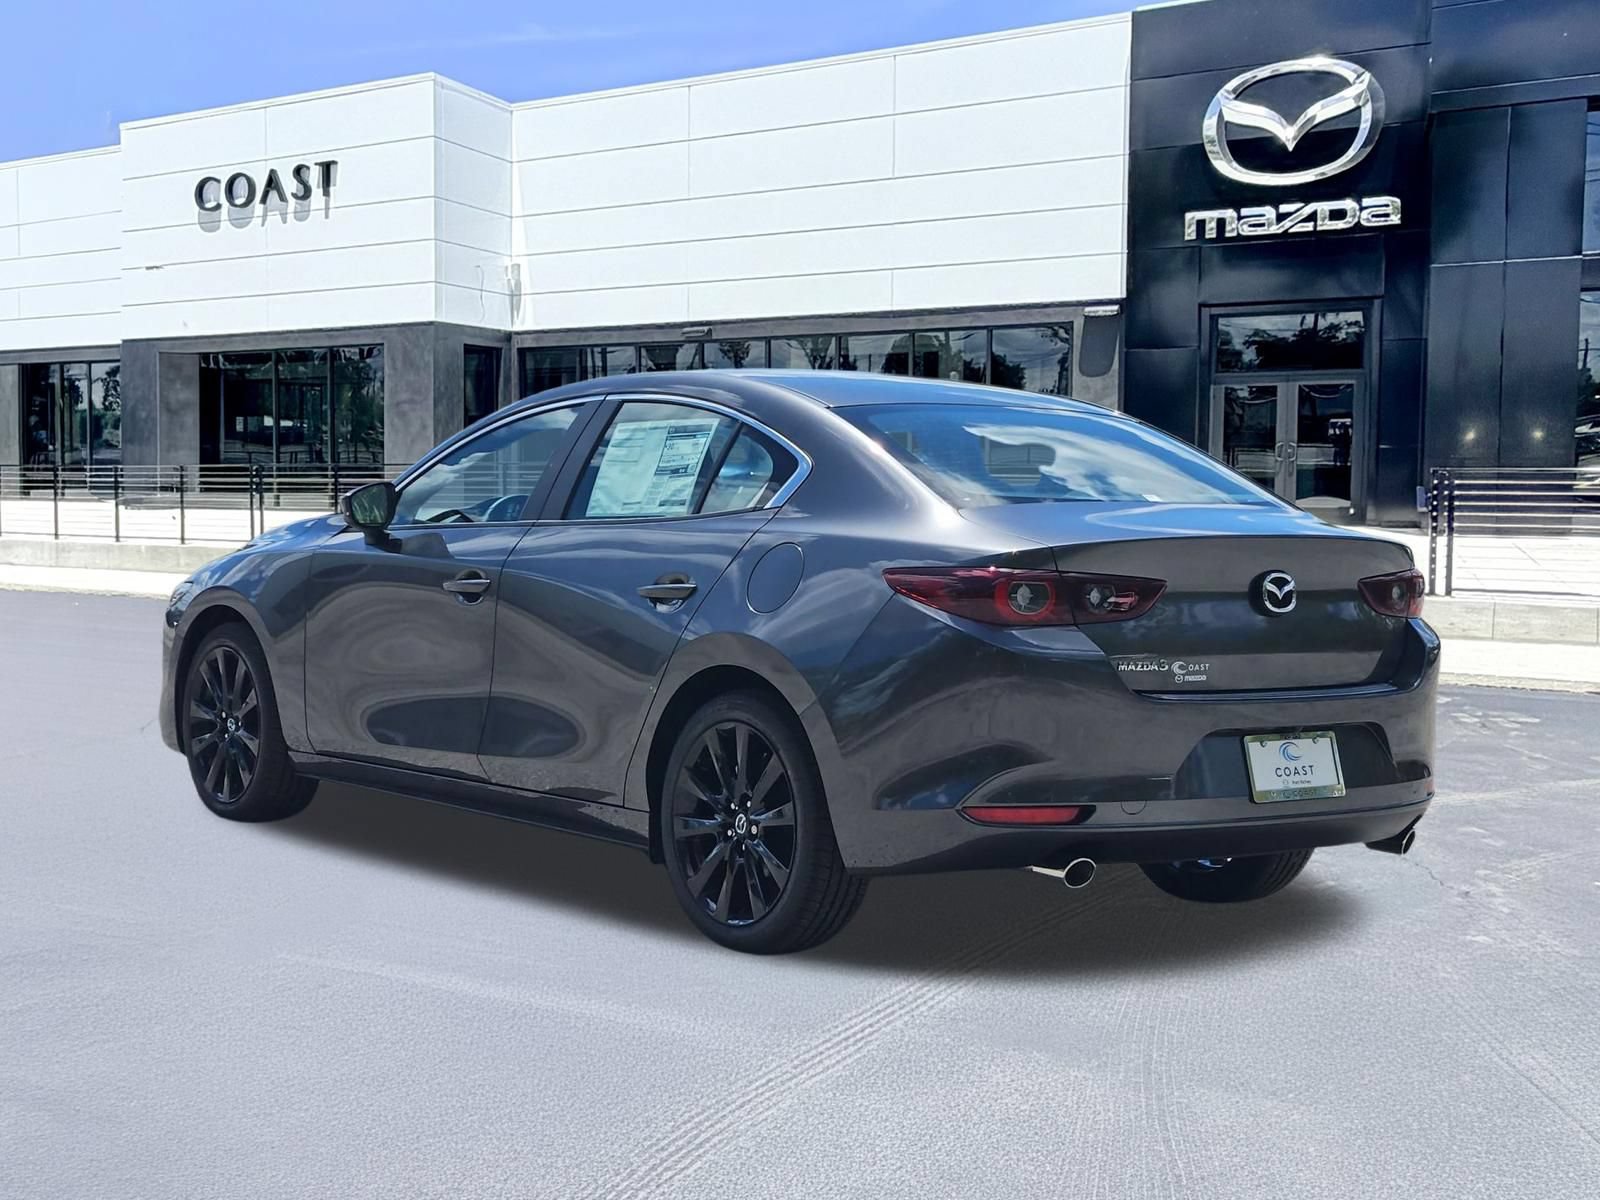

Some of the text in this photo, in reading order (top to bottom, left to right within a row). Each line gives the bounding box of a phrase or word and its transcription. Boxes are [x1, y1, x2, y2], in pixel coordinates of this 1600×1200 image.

[194, 160, 338, 212] COAST
[1184, 196, 1402, 241] mazda
[1275, 764, 1315, 778] COAST
